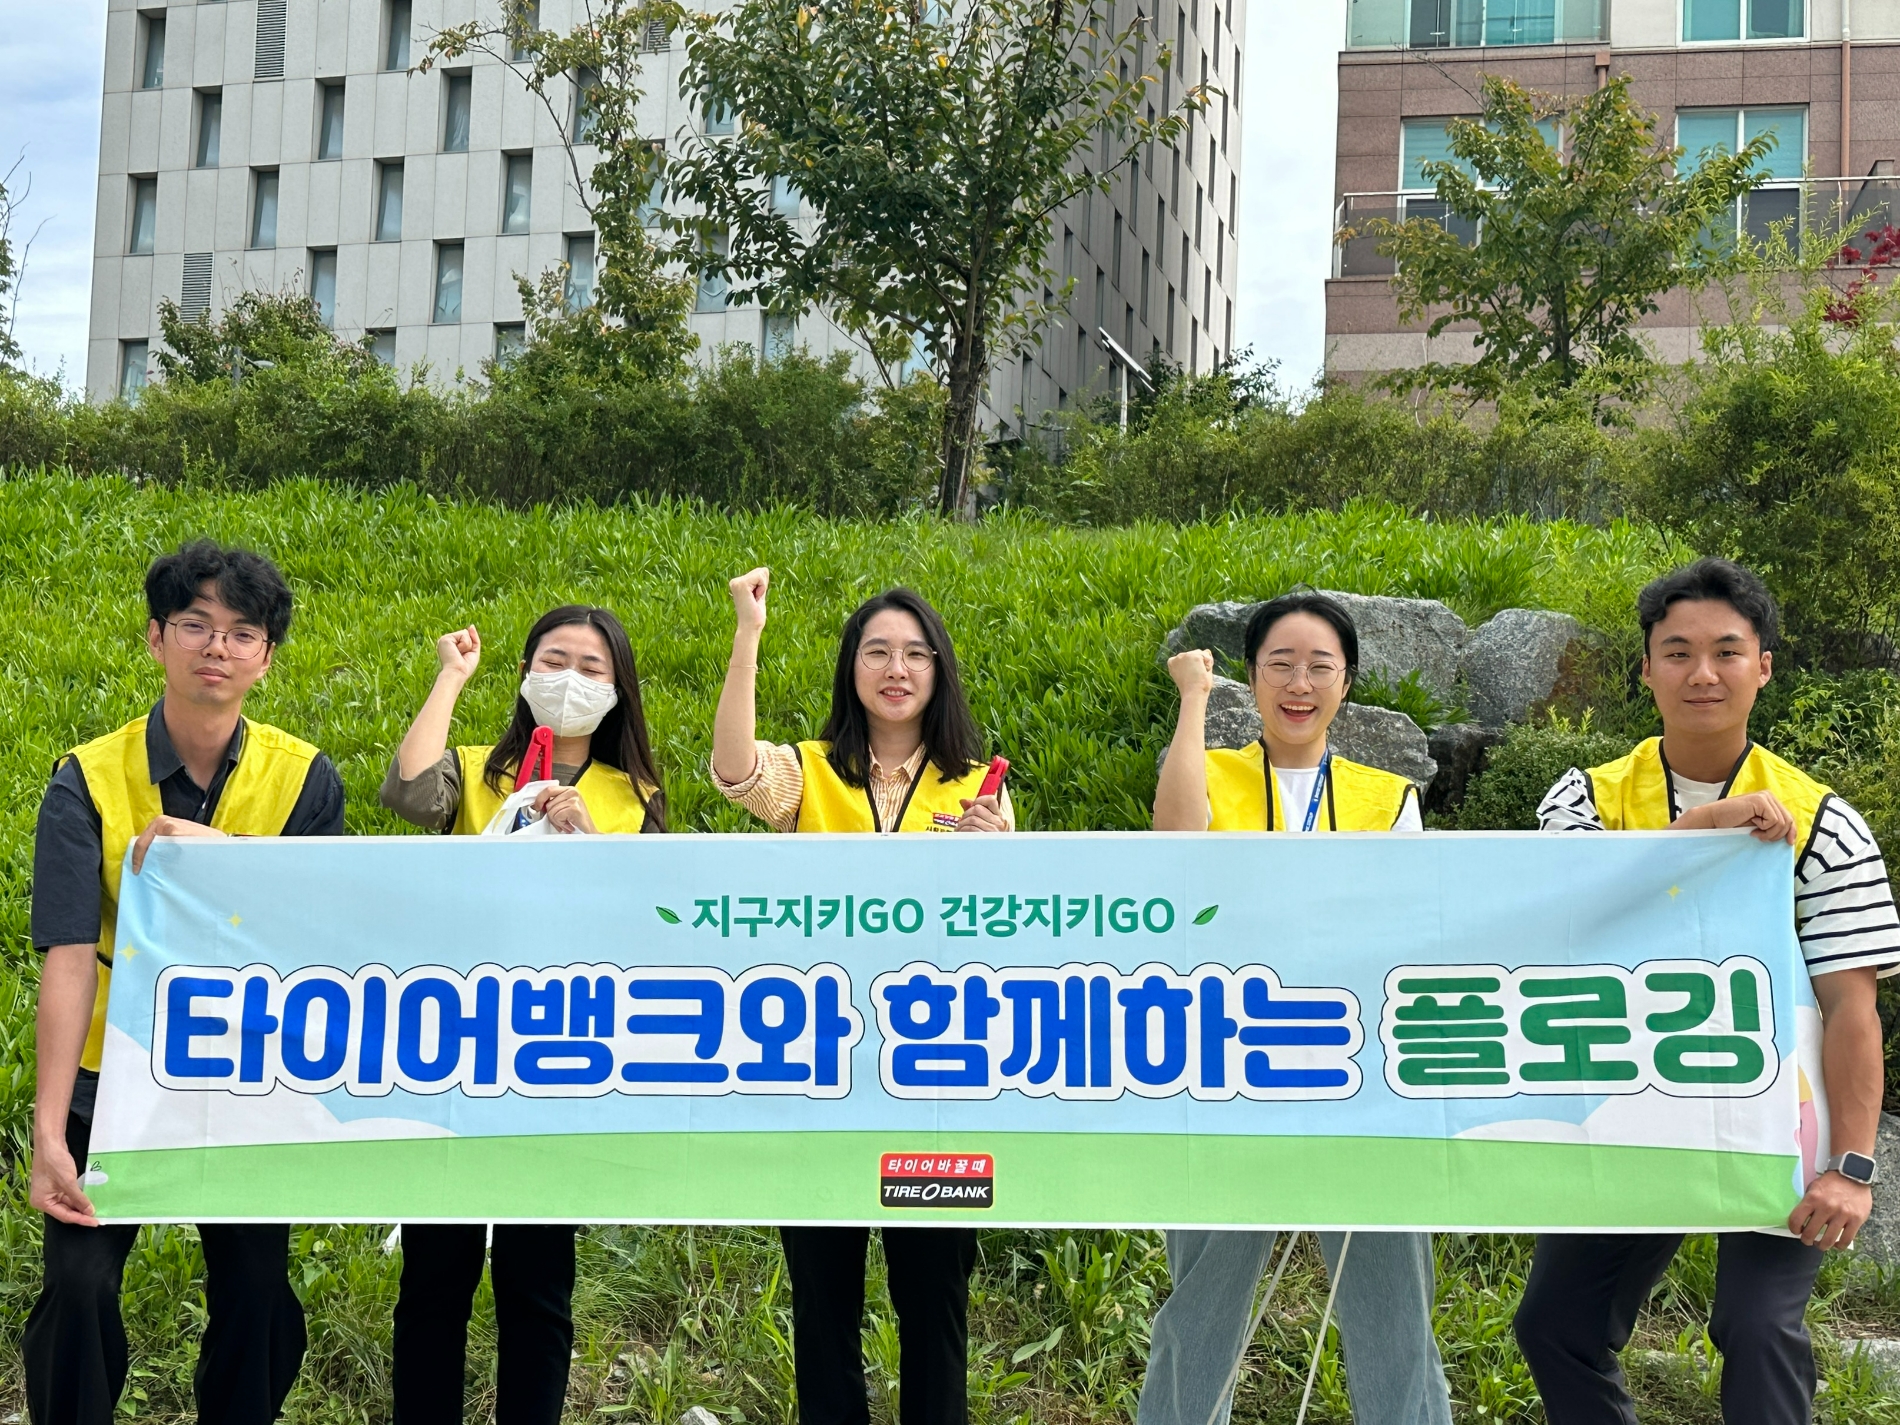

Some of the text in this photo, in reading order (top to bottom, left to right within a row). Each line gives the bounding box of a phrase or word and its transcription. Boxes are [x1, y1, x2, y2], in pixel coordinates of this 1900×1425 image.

[692, 894, 1176, 938] 지구지키GO 건강지키GO
[163, 968, 1766, 1088] 타이어뱅크와 함께하는 플로깅
